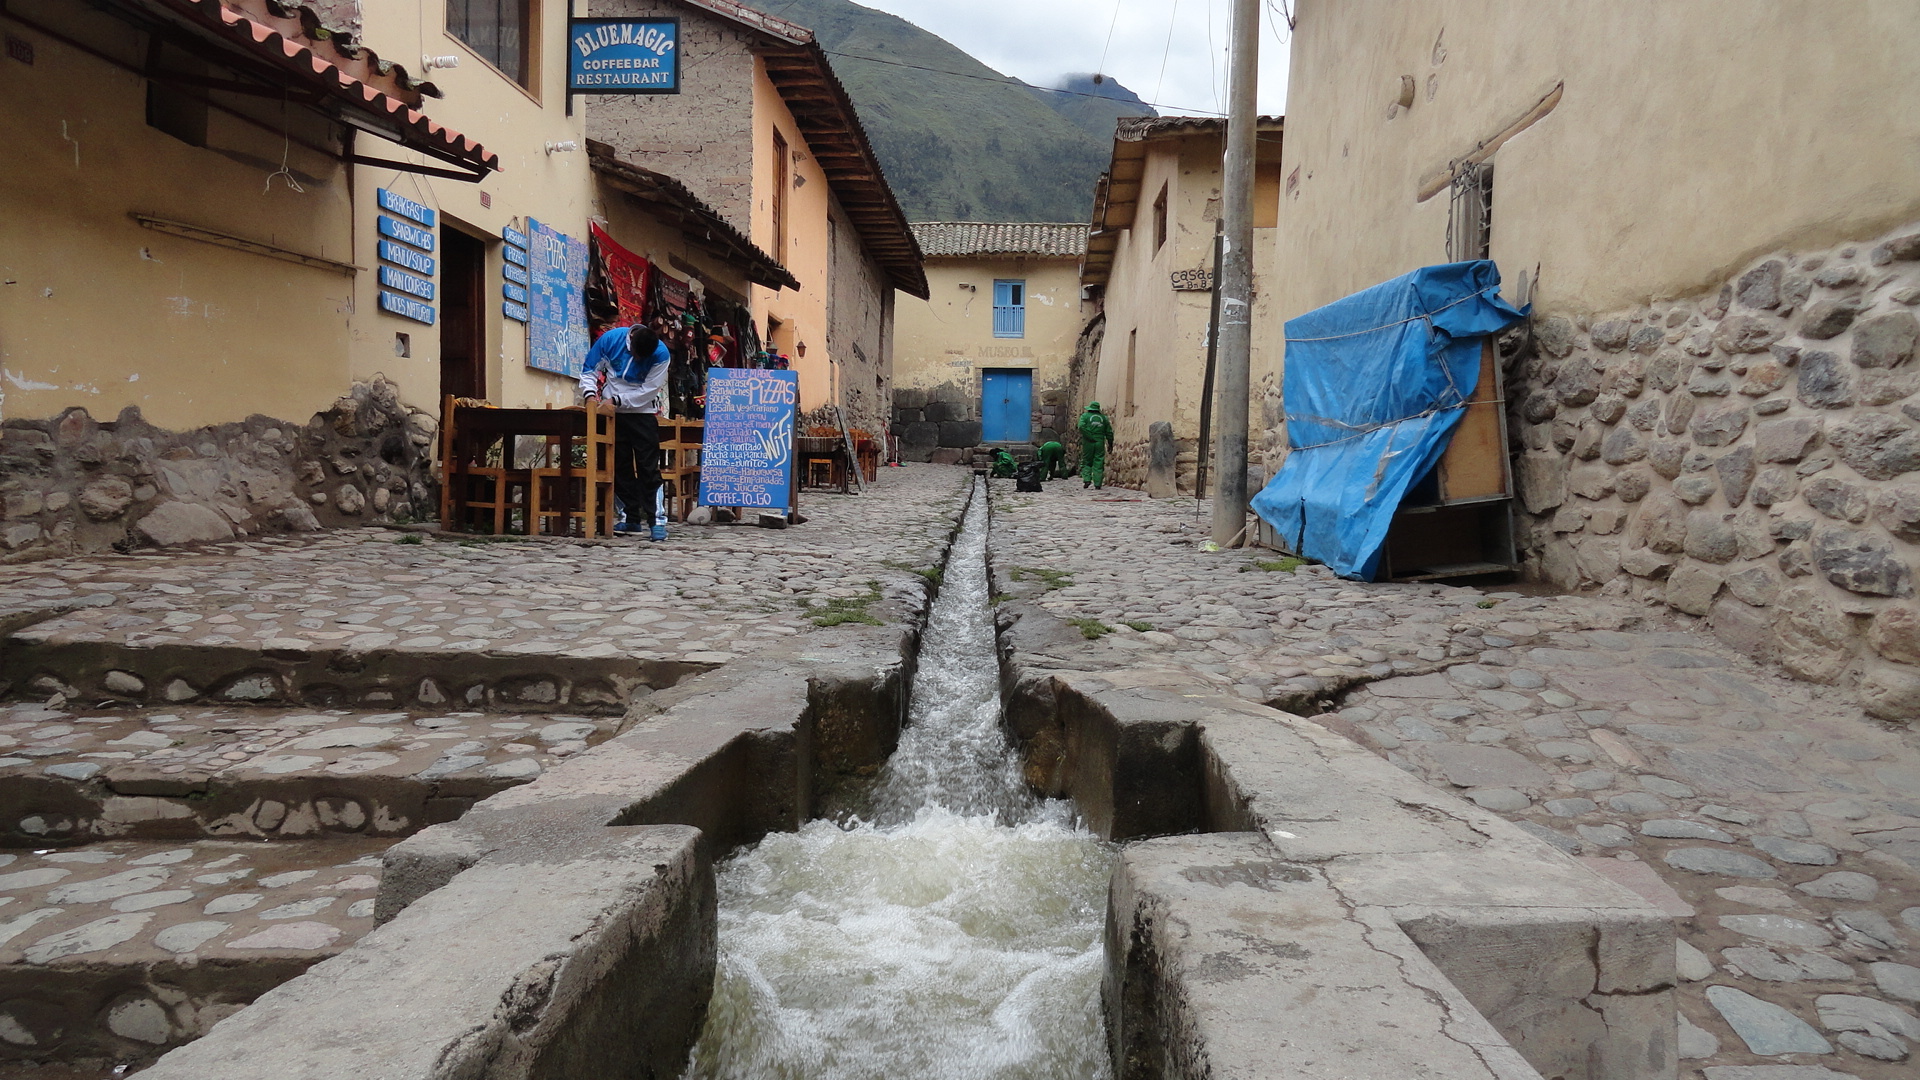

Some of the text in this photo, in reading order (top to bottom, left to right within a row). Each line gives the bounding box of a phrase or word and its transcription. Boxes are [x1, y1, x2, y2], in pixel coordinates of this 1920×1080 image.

[583, 58, 659, 70] COFFEE BAR
[576, 72, 670, 85] RESTAURANT
[386, 190, 427, 222] BREAKFAST
[392, 220, 431, 250] SANDWICHES
[386, 268, 432, 300] MAIN COURSES
[978, 345, 1020, 358] MUSEO
[728, 369, 774, 379] BLUE MAGIC
[709, 377, 747, 388] Breakfast
[710, 386, 750, 397] Sandwiches
[730, 442, 762, 451] montado
[733, 482, 766, 493] Juices
